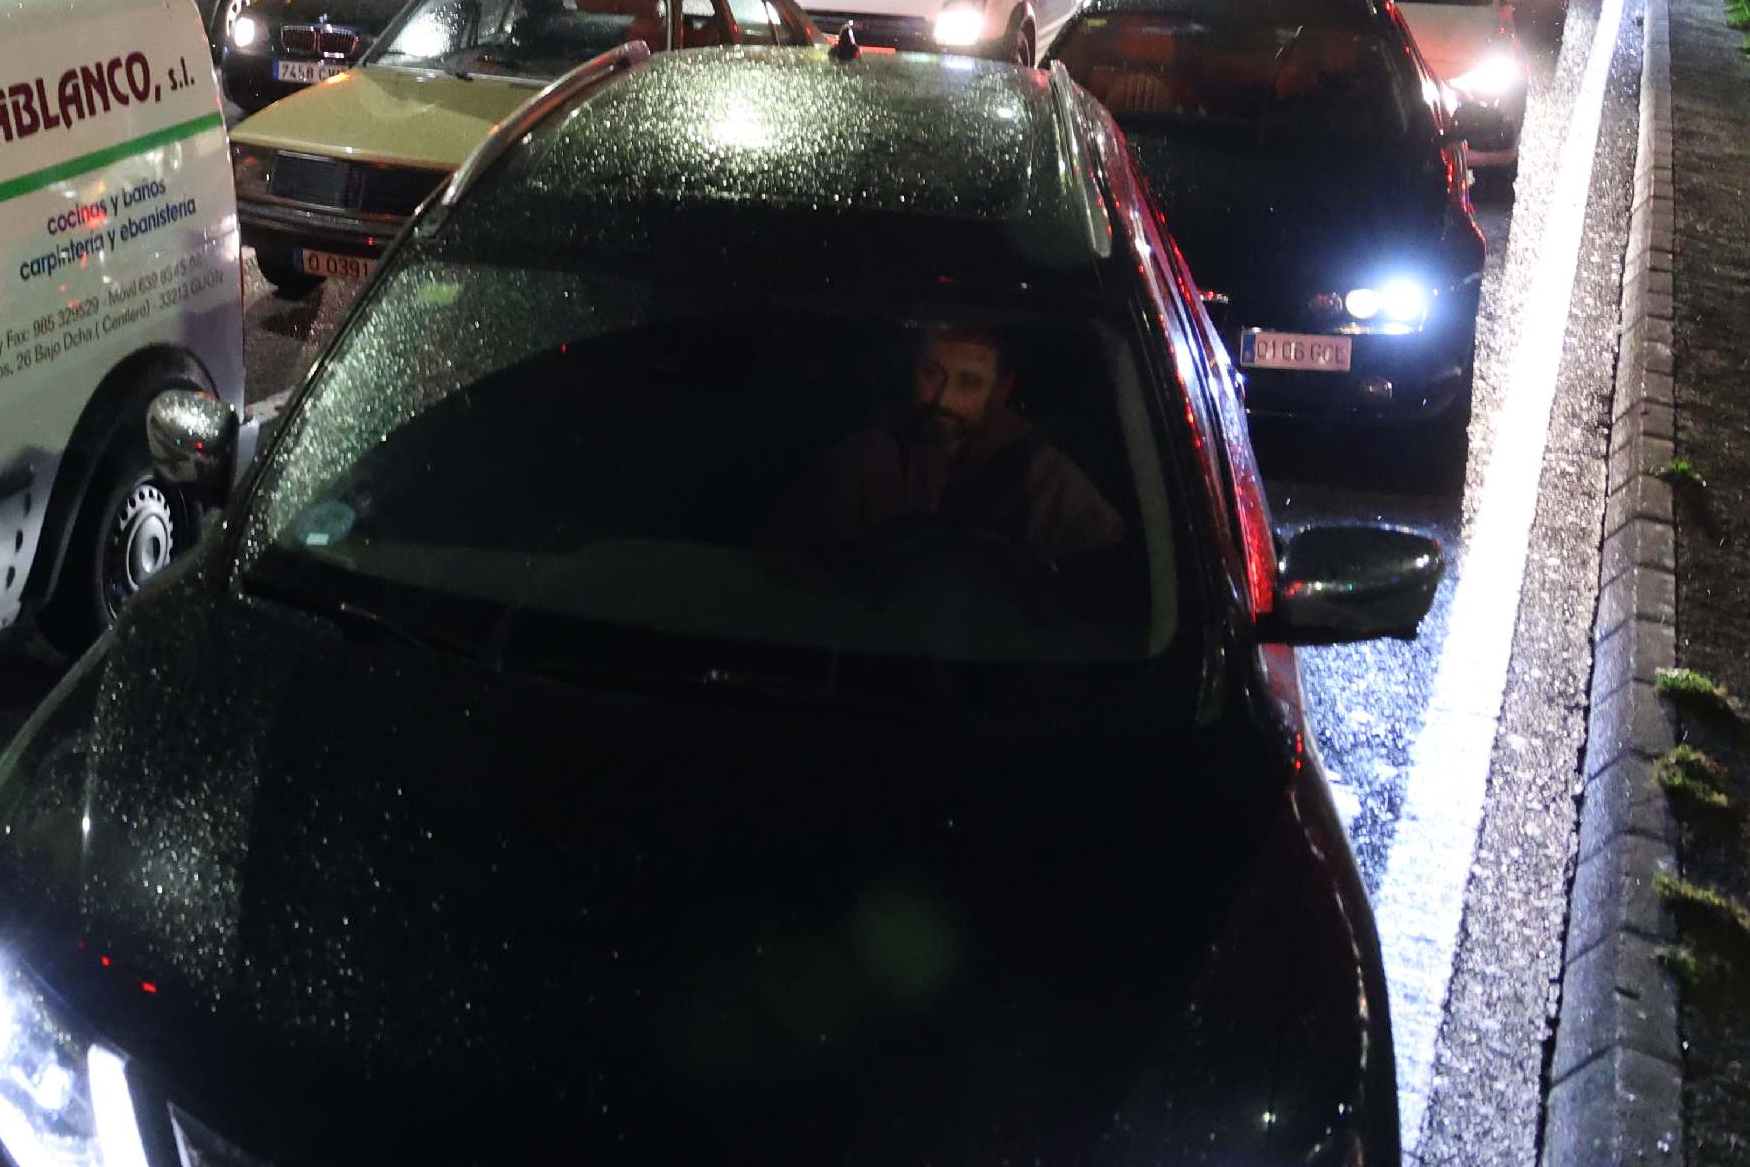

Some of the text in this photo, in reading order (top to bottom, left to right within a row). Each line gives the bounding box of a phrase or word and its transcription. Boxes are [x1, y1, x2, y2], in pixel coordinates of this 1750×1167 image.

[168, 56, 195, 91] s.l.
[47, 177, 167, 235] cocinas y baños
[107, 228, 118, 251] y
[33, 313, 55, 338] 985
[34, 341, 61, 364] Bajo
